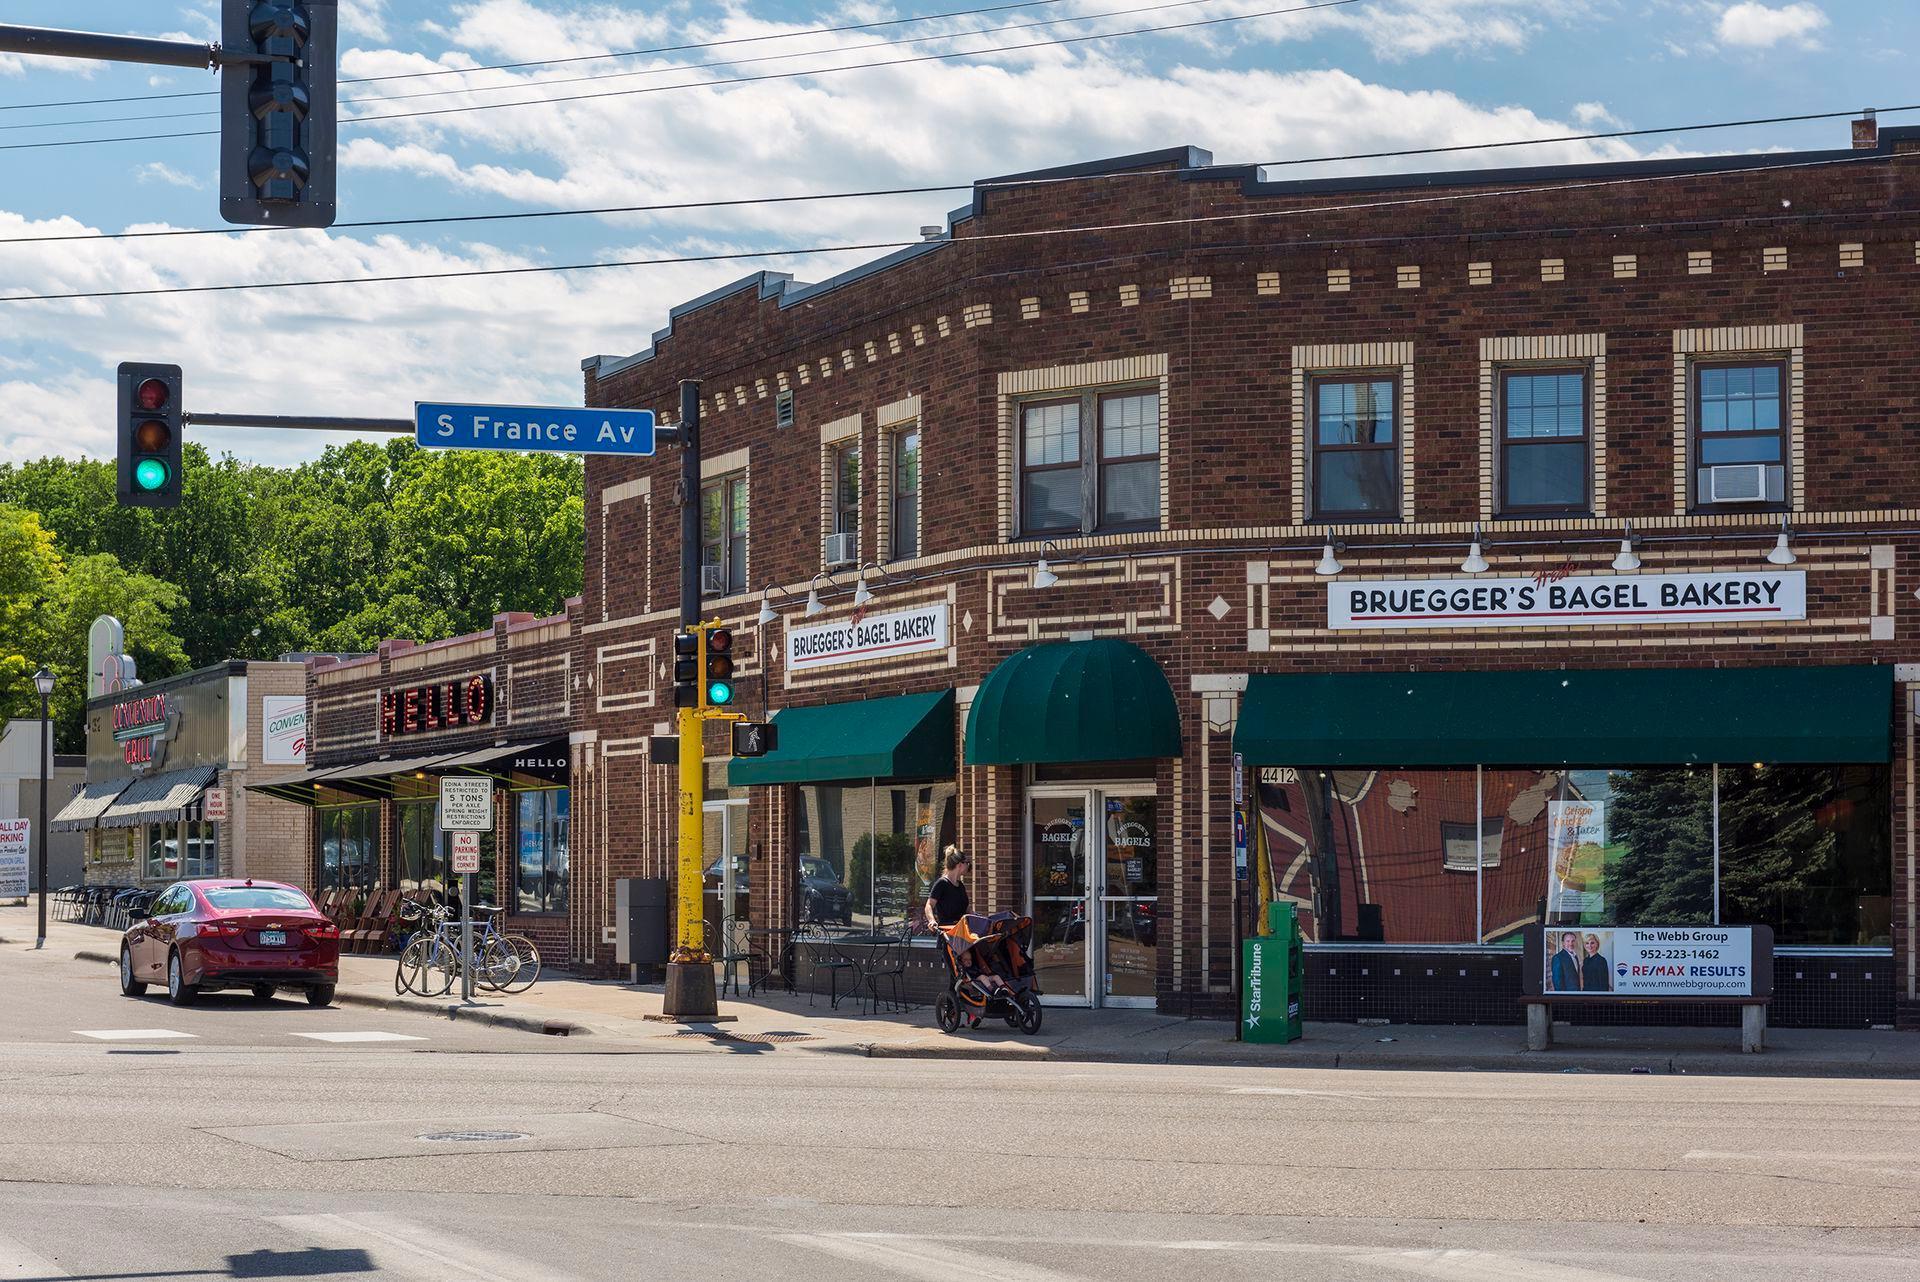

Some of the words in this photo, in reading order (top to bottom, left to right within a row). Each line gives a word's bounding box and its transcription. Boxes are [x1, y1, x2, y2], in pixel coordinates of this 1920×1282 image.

[437, 414, 455, 437] S
[473, 416, 577, 441] France
[596, 421, 635, 443] Av
[1350, 586, 1535, 613] BRUEGGER'S
[1549, 584, 1647, 609] BAGEL
[1662, 580, 1781, 606] BAKERY
[793, 628, 854, 657] BRUEGGER'S
[857, 623, 890, 647] BAGEL
[894, 614, 937, 641] BAKERY
[382, 674, 493, 735] HELLO
[125, 736, 152, 764] GRILL
[515, 759, 567, 768] HELLO
[1262, 768, 1294, 783] 4412
[449, 794, 456, 802] 5
[460, 794, 484, 802] TONS
[1564, 805, 1593, 817] Crispy
[14, 821, 28, 831] DAY
[0, 833, 24, 843] RKING
[460, 836, 472, 844] NO
[1041, 833, 1078, 842] BAGELS
[1114, 837, 1150, 847] BAGELS
[1634, 931, 1655, 941] The
[1657, 931, 1690, 941] Webb
[1692, 931, 1729, 944] Group
[1640, 950, 1719, 959] 952-223-1462
[1632, 966, 1685, 976] RE/MAX
[1690, 966, 1746, 976] RESULTS
[1632, 980, 1746, 990] www.mnwebbgroup.com
